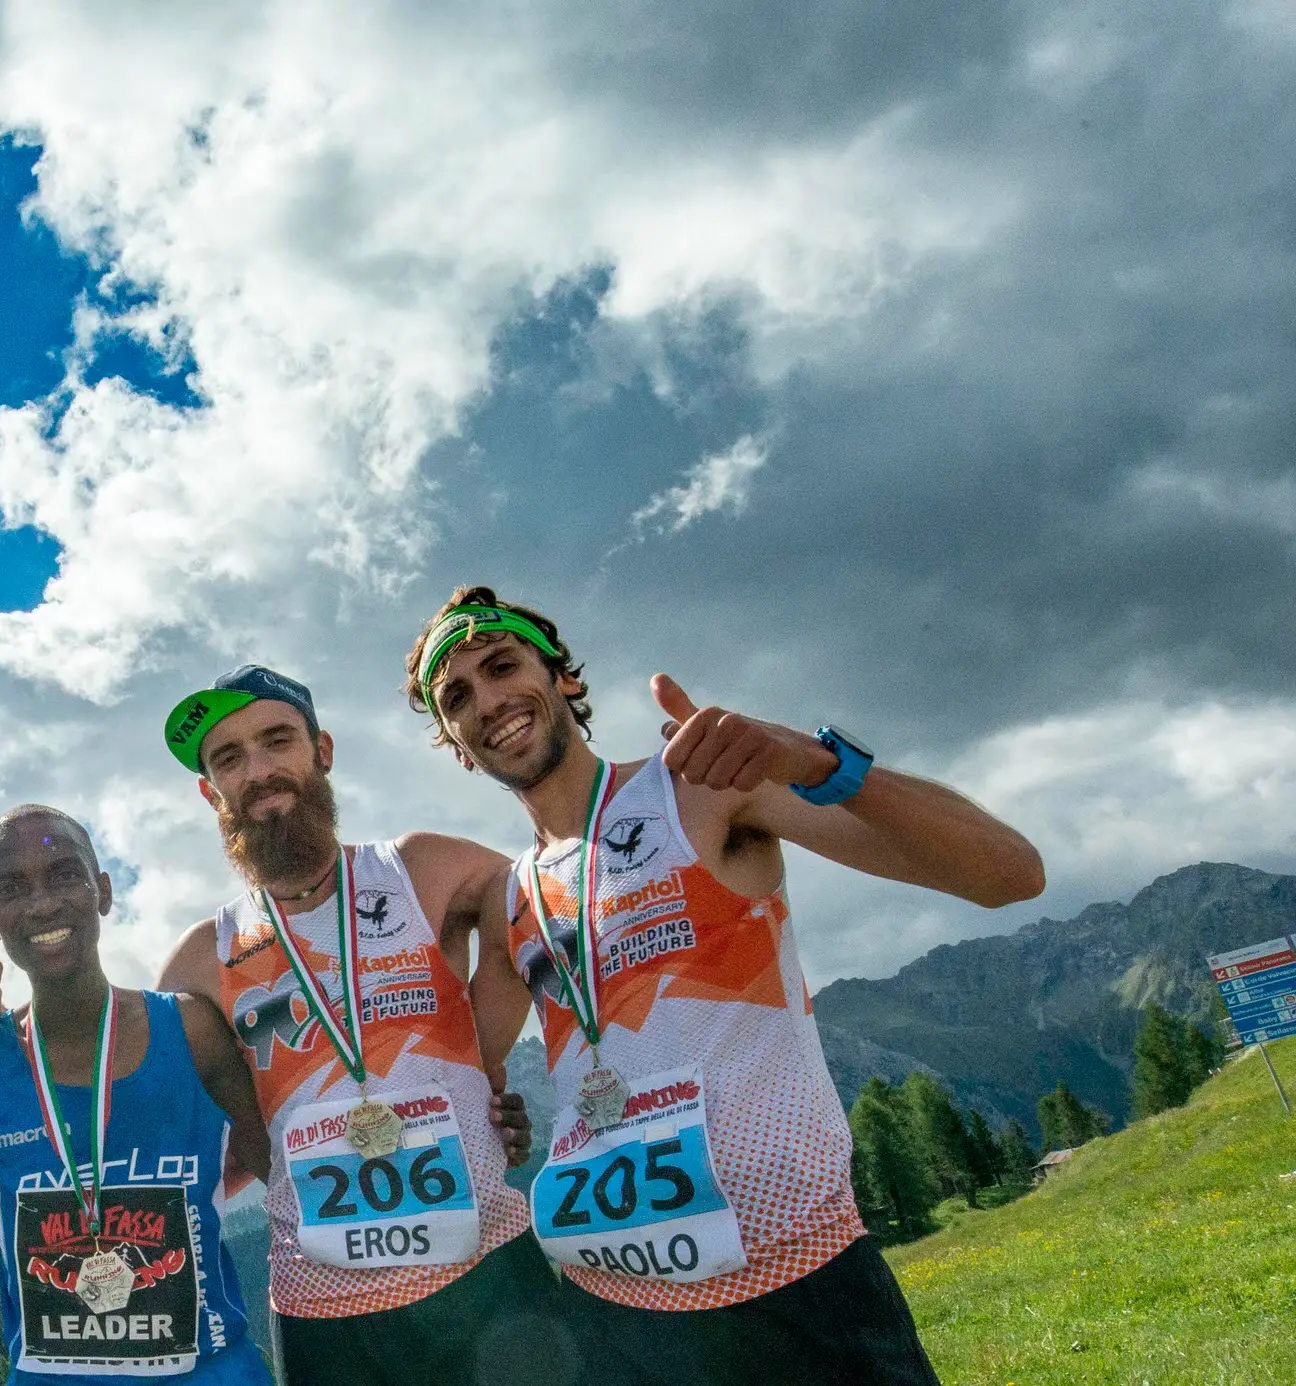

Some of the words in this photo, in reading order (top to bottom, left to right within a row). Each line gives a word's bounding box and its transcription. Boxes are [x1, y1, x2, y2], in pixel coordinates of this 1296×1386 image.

[169, 701, 210, 745] VAM
[623, 902, 684, 926] ANNIVERSARY
[610, 919, 690, 957] BUILDING
[628, 934, 694, 965] FUTURE
[377, 972, 431, 985] ANNIVERSARY
[362, 989, 435, 1009] BUILDING
[379, 1001, 437, 1018] FUTURE
[1267, 1026, 1296, 1036] Sellaro
[435, 1114, 451, 1124] FASSA
[650, 1111, 665, 1122] DELLA
[666, 1108, 675, 1117] VAL
[683, 1100, 700, 1112] FASSA
[286, 1128, 307, 1149] VAL
[320, 1110, 350, 1138] FASS
[552, 1134, 570, 1157] VAL
[308, 1146, 457, 1219] 206
[552, 1138, 696, 1228] 205
[40, 1211, 74, 1244] VAL
[105, 1205, 165, 1241] FASSA
[345, 1224, 431, 1260] EROS
[578, 1233, 699, 1277] PAOLO
[41, 1313, 174, 1340] LEADER
